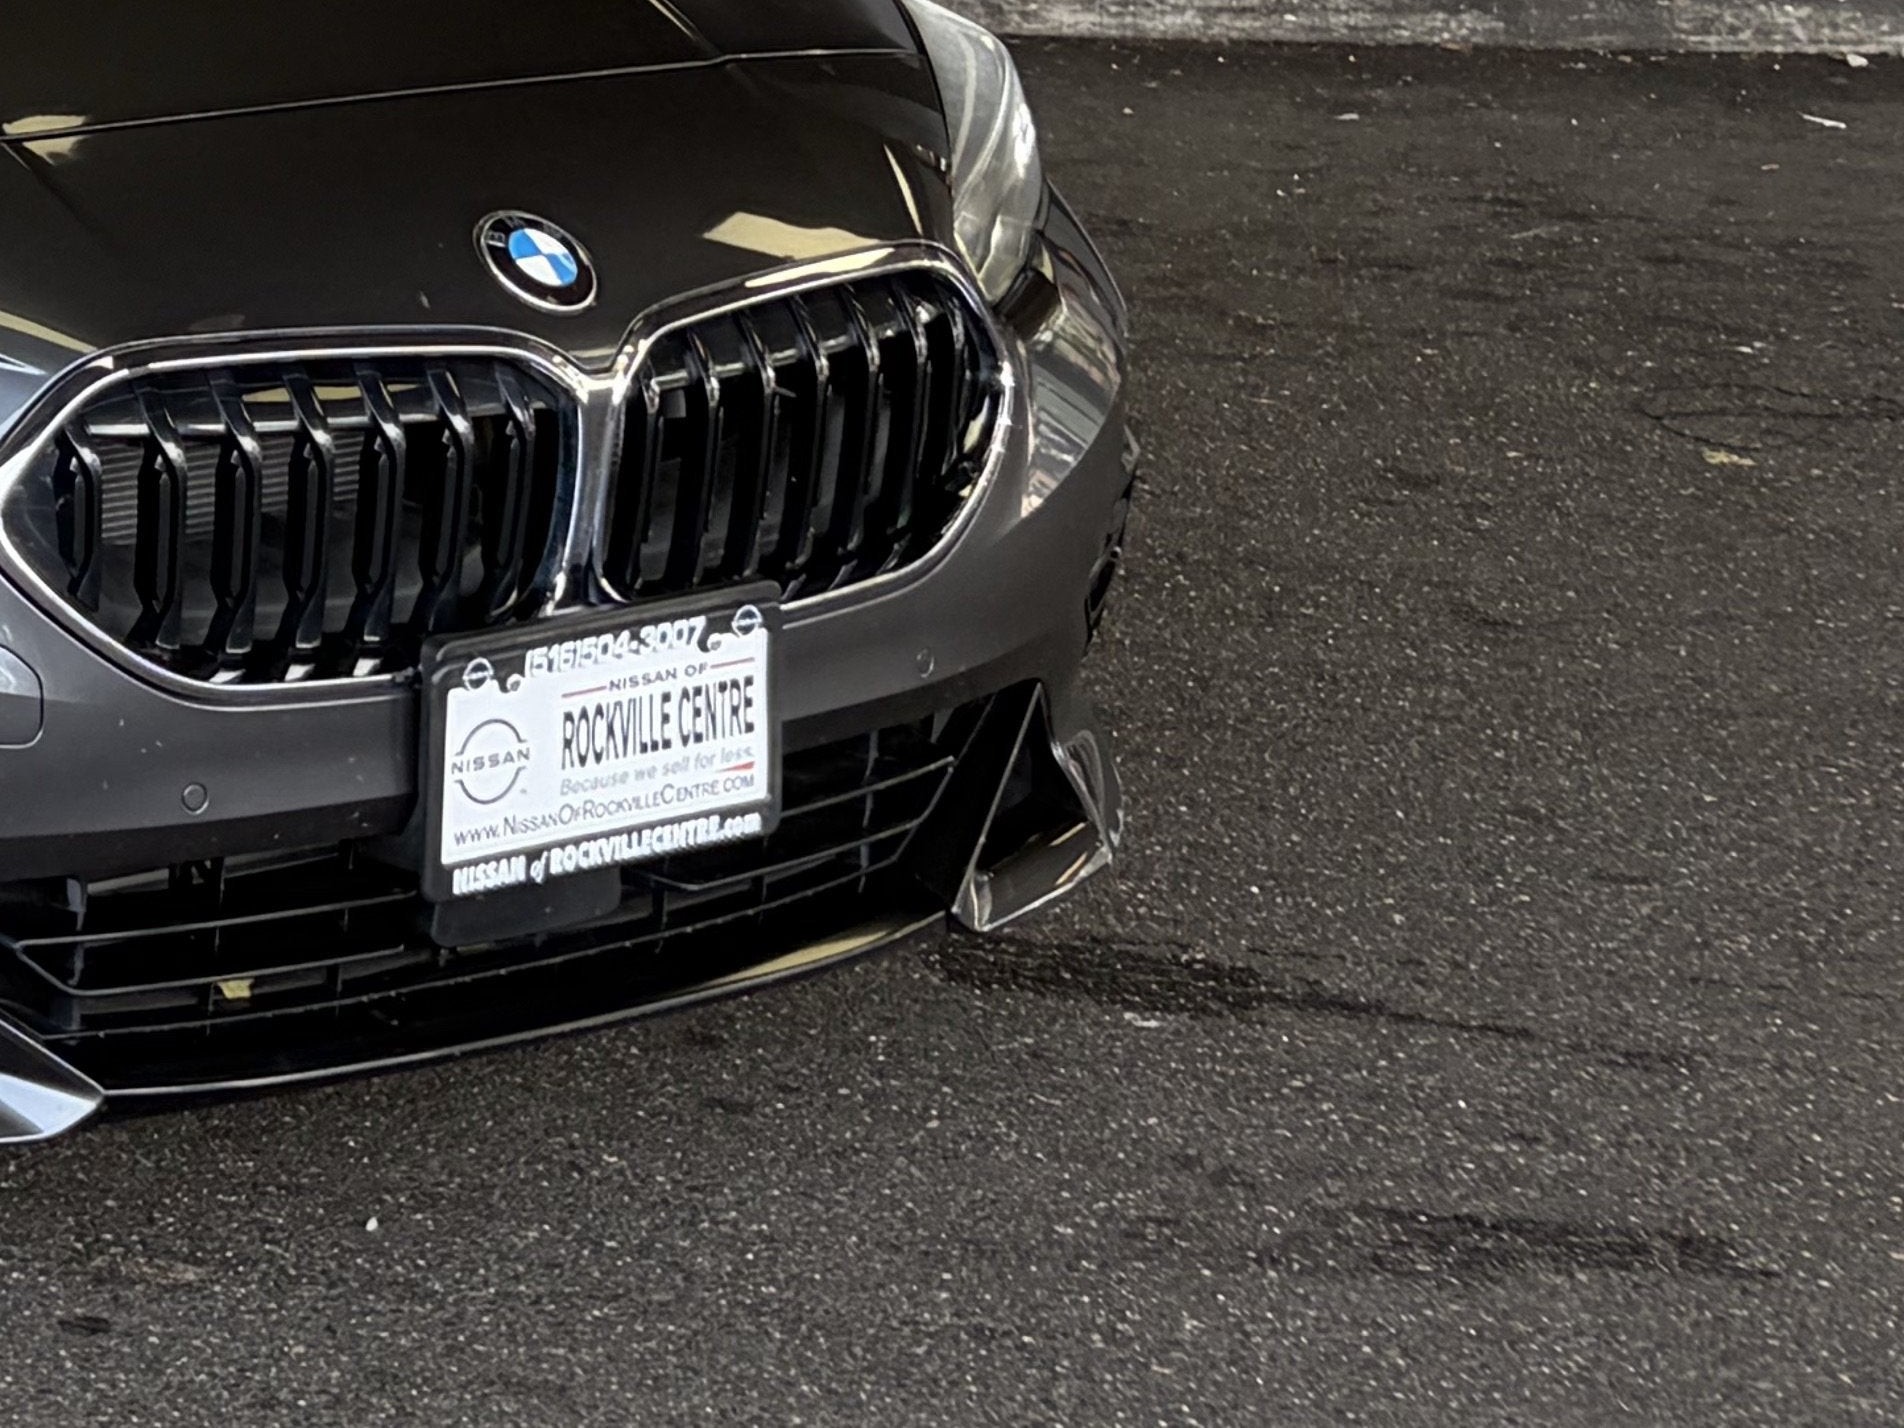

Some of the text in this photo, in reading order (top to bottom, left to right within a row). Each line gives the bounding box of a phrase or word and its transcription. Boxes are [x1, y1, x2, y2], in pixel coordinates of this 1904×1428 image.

[608, 661, 709, 692] NISSAN OF
[560, 674, 755, 771] ROCKVILLE CENTRE
[450, 746, 531, 776] NISSAN
[559, 770, 630, 797] Because
[634, 763, 658, 783] we
[661, 755, 691, 777] sell
[693, 751, 716, 771] for
[452, 855, 527, 896] NISSAN
[530, 850, 549, 884] of
